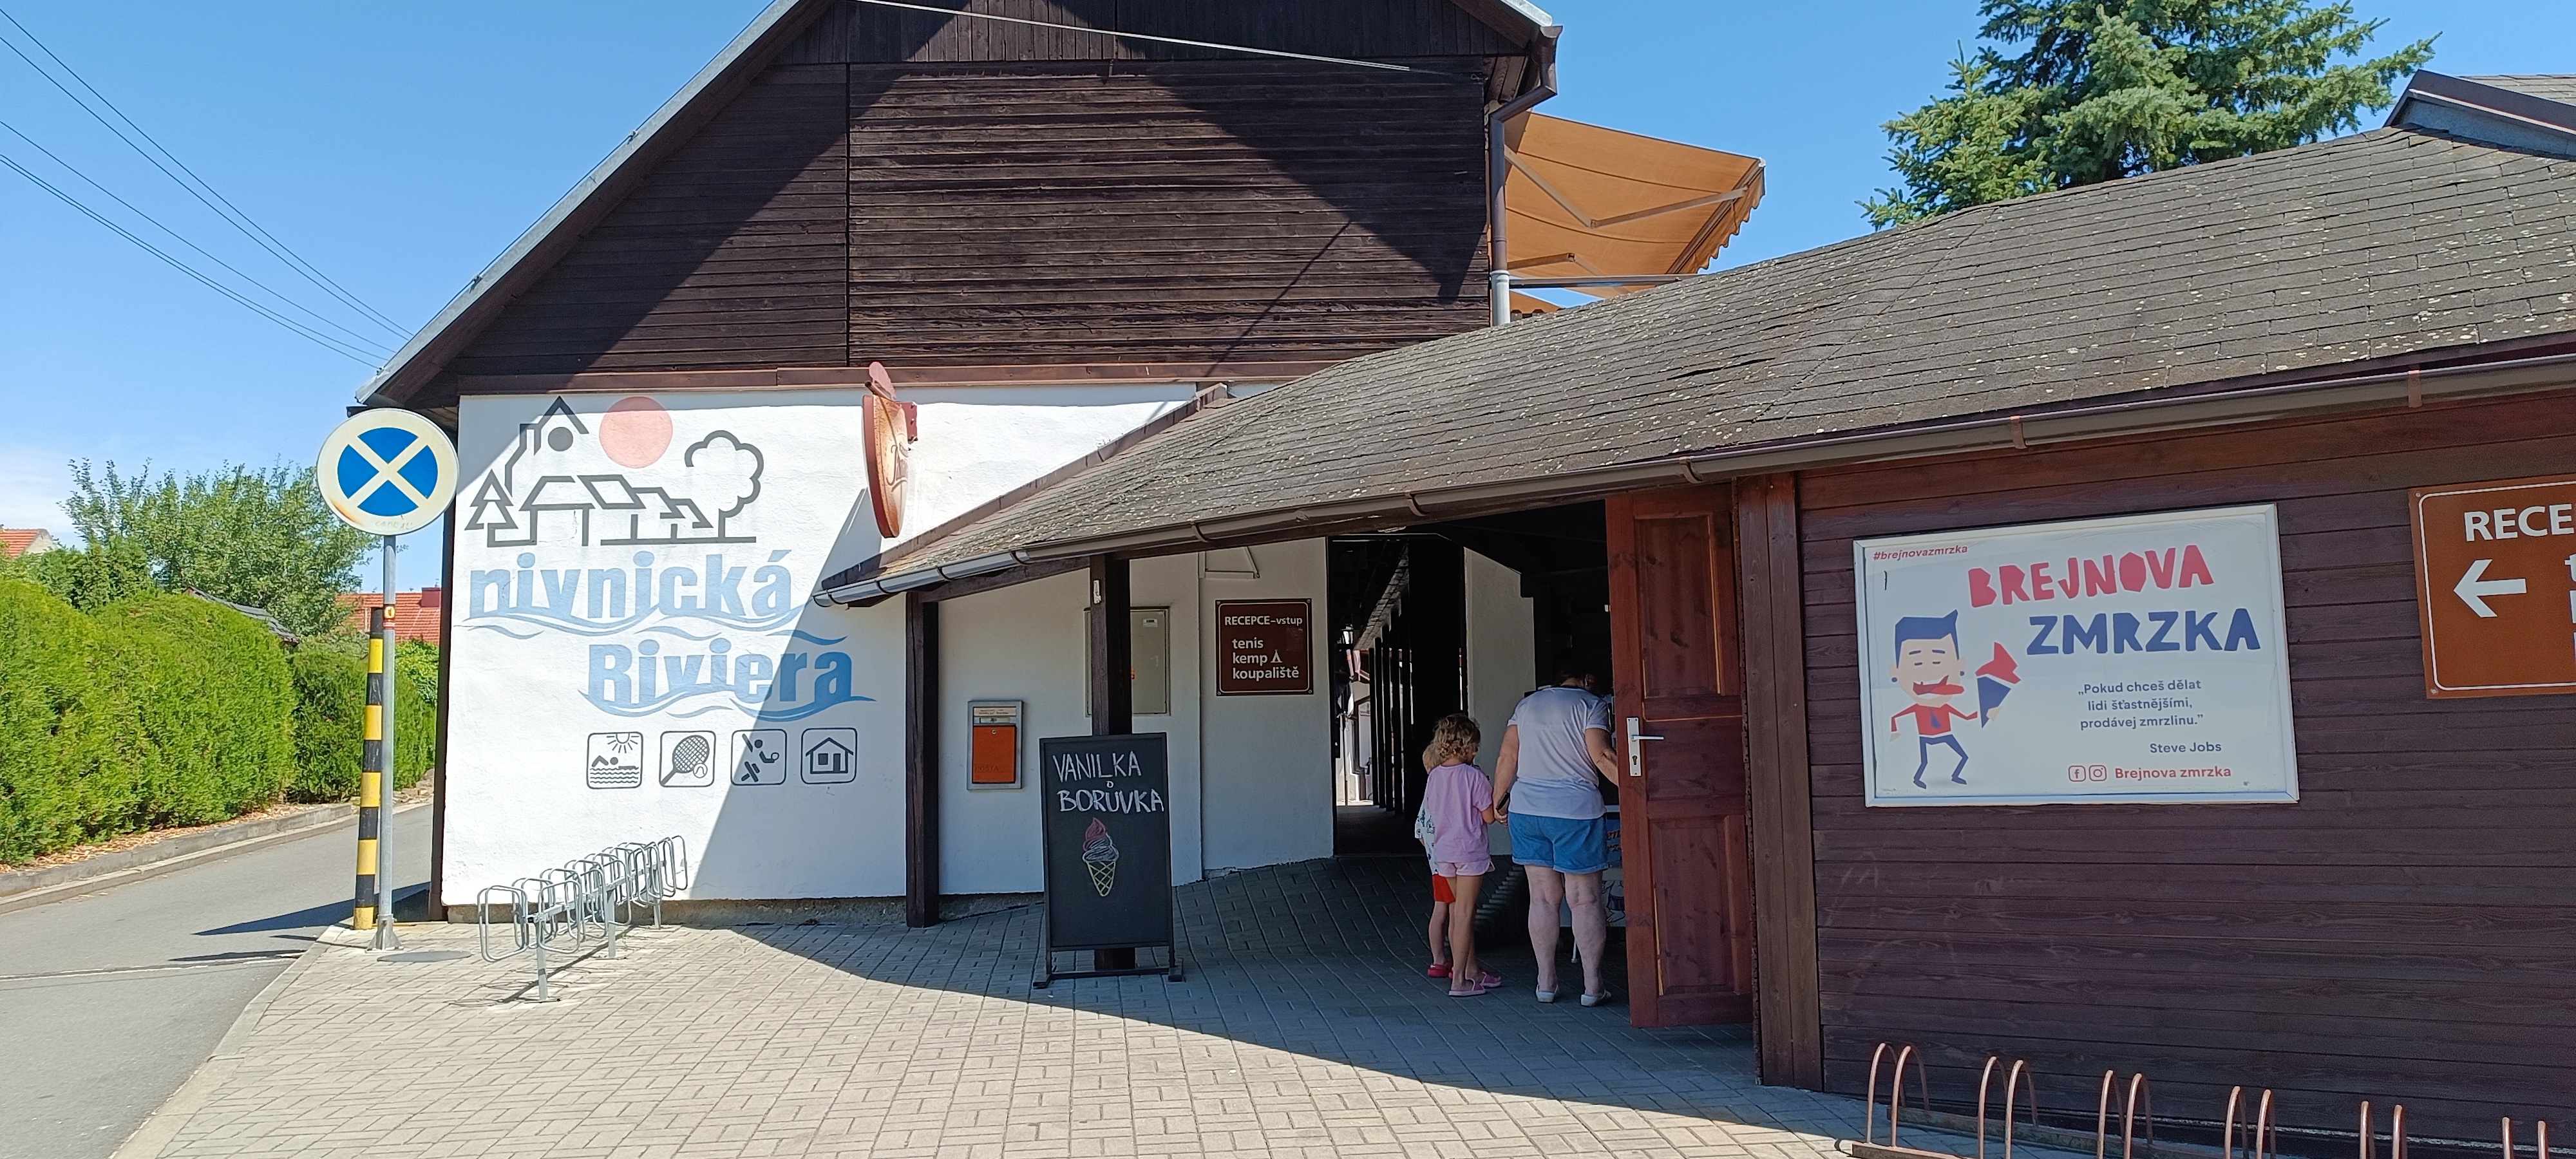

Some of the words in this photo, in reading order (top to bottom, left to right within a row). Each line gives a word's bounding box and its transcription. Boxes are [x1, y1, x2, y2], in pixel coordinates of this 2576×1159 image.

[1873, 544, 1968, 561] #brejnovazmrzka
[469, 549, 793, 619] nivnická
[1968, 545, 2214, 608] BREJNOVA
[2027, 608, 2261, 655] ZMRZKA
[1231, 636, 1264, 649] tenis
[1233, 652, 1268, 666] kemp
[587, 637, 853, 706] Riviera
[1233, 666, 1300, 682] koupaliště
[2126, 680, 2164, 692] chceš
[2168, 679, 2202, 690] dělat
[2088, 700, 2107, 711] lidi
[2112, 697, 2193, 711] šťastnějšími,
[2080, 717, 2137, 731] prodávej
[2150, 743, 2186, 753] Steve
[2189, 742, 2222, 752] Jobs
[1052, 749, 1142, 783] VANILKA
[2115, 767, 2177, 781] Brejnova
[2180, 766, 2232, 778] zmrzka
[1056, 780, 1164, 815] BORŮVKA
